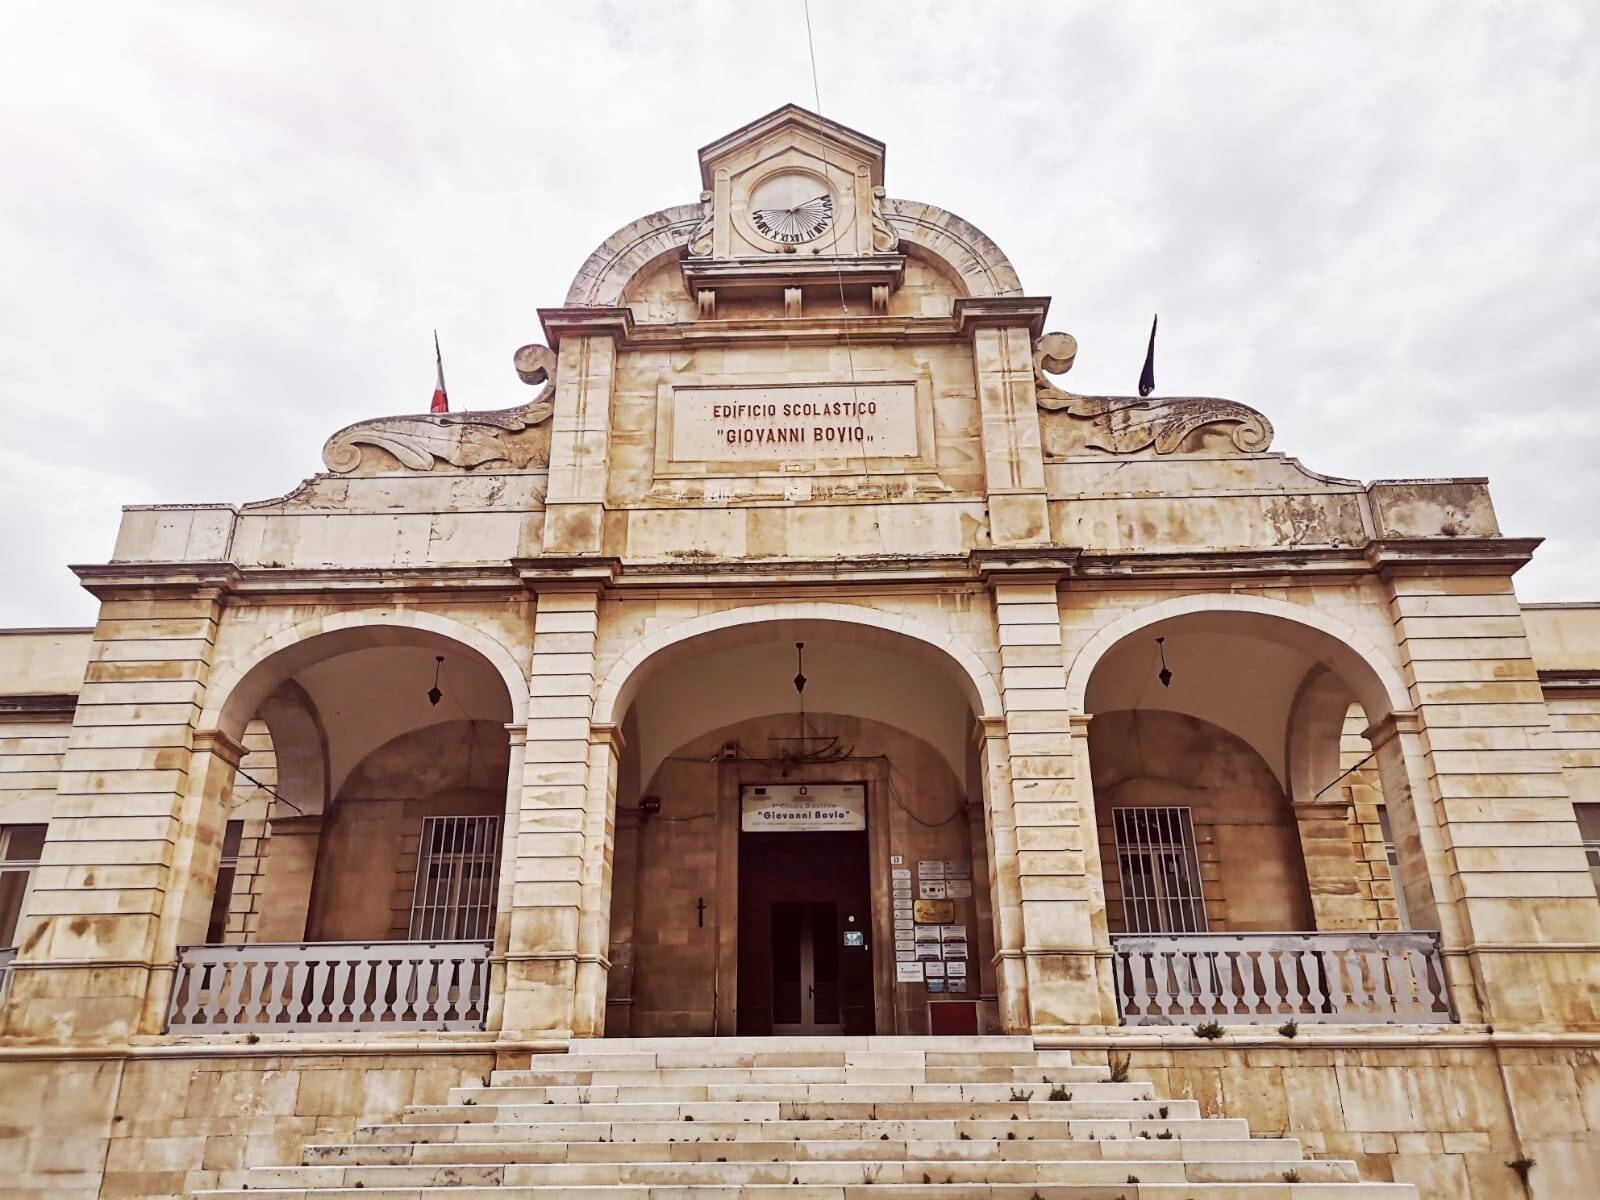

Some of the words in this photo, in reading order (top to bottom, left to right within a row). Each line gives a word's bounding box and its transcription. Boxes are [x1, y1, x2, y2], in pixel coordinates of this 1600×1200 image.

[713, 404, 776, 418] EDIFICIO
[783, 402, 877, 416] SCOLASTICO
[717, 427, 805, 443] "GIOVANNI
[758, 811, 812, 819] "Giovanni
[815, 811, 850, 819] Bovio"
